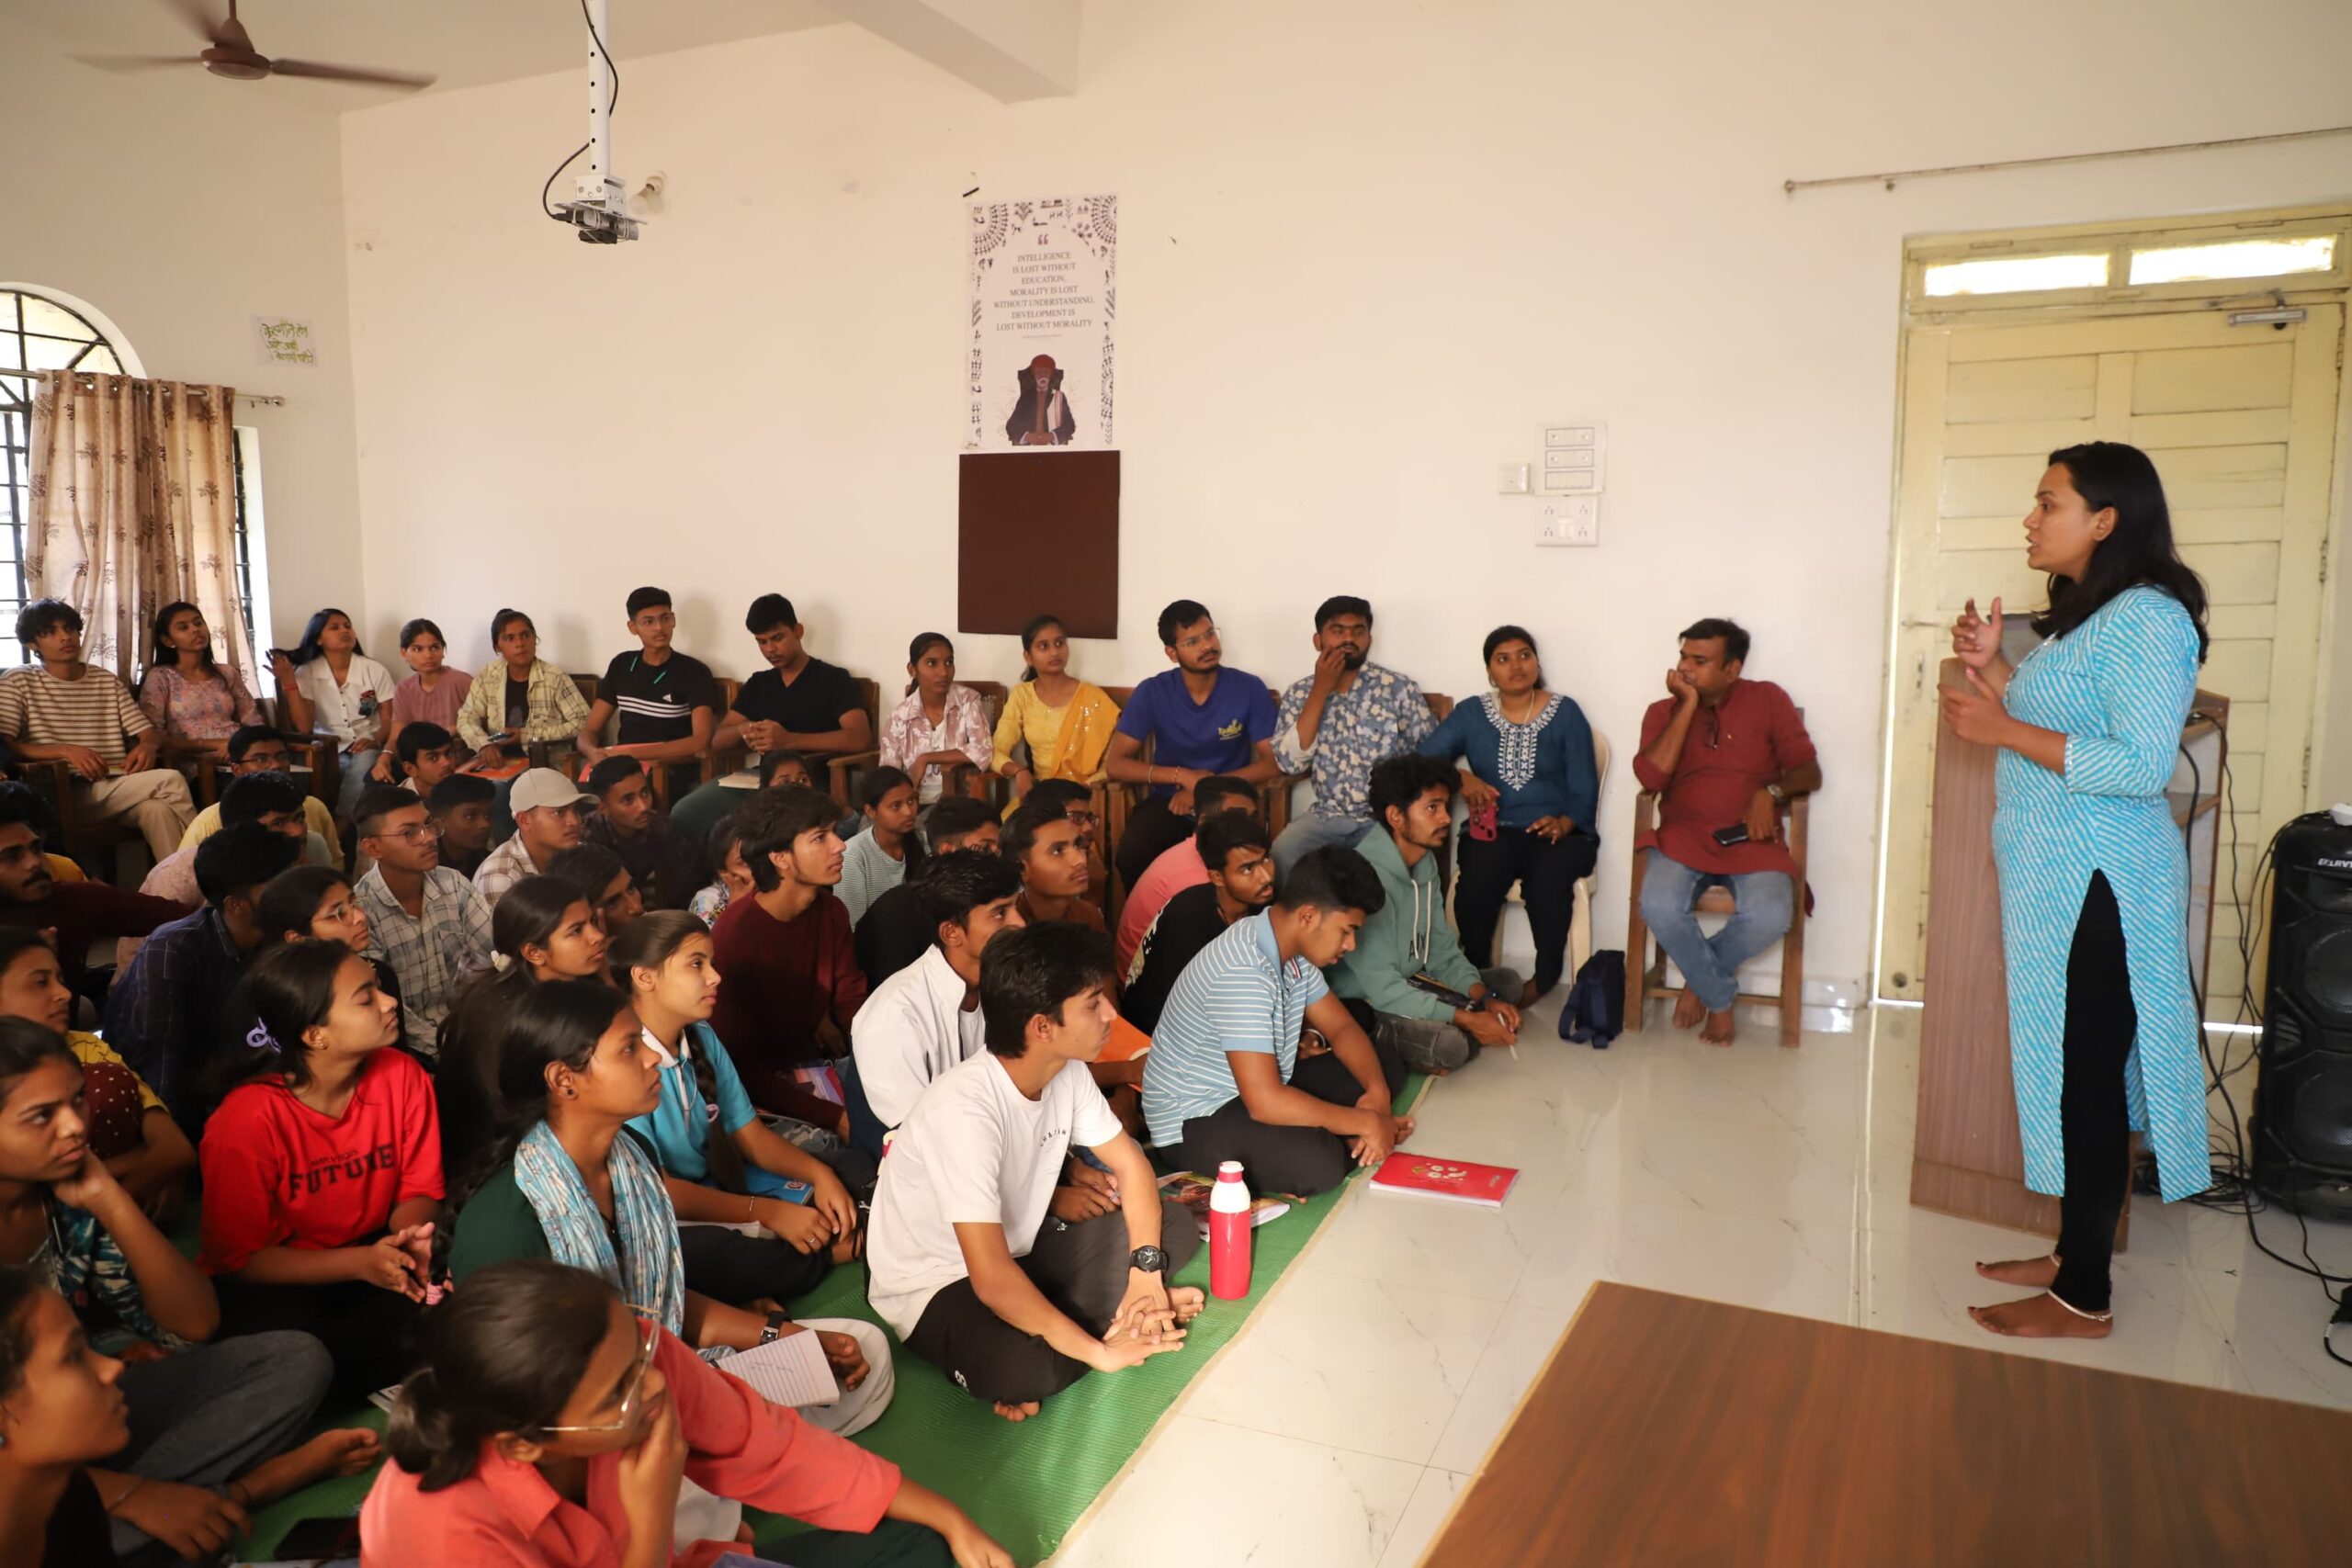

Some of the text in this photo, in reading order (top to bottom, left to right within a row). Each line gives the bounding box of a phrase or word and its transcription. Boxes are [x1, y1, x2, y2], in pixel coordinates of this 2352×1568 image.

[1017, 252, 1071, 263] INTELLIGENCE
[1021, 265, 1039, 274] LOST
[1041, 263, 1077, 272] WITHOUT
[1010, 287, 1049, 296] MORALITY
[1059, 285, 1078, 294] LOST
[993, 299, 1028, 309] WITHOUT
[1012, 309, 1068, 319] DEVELOPMENT
[996, 319, 1092, 332] LOST WITHOUT MORALITY
